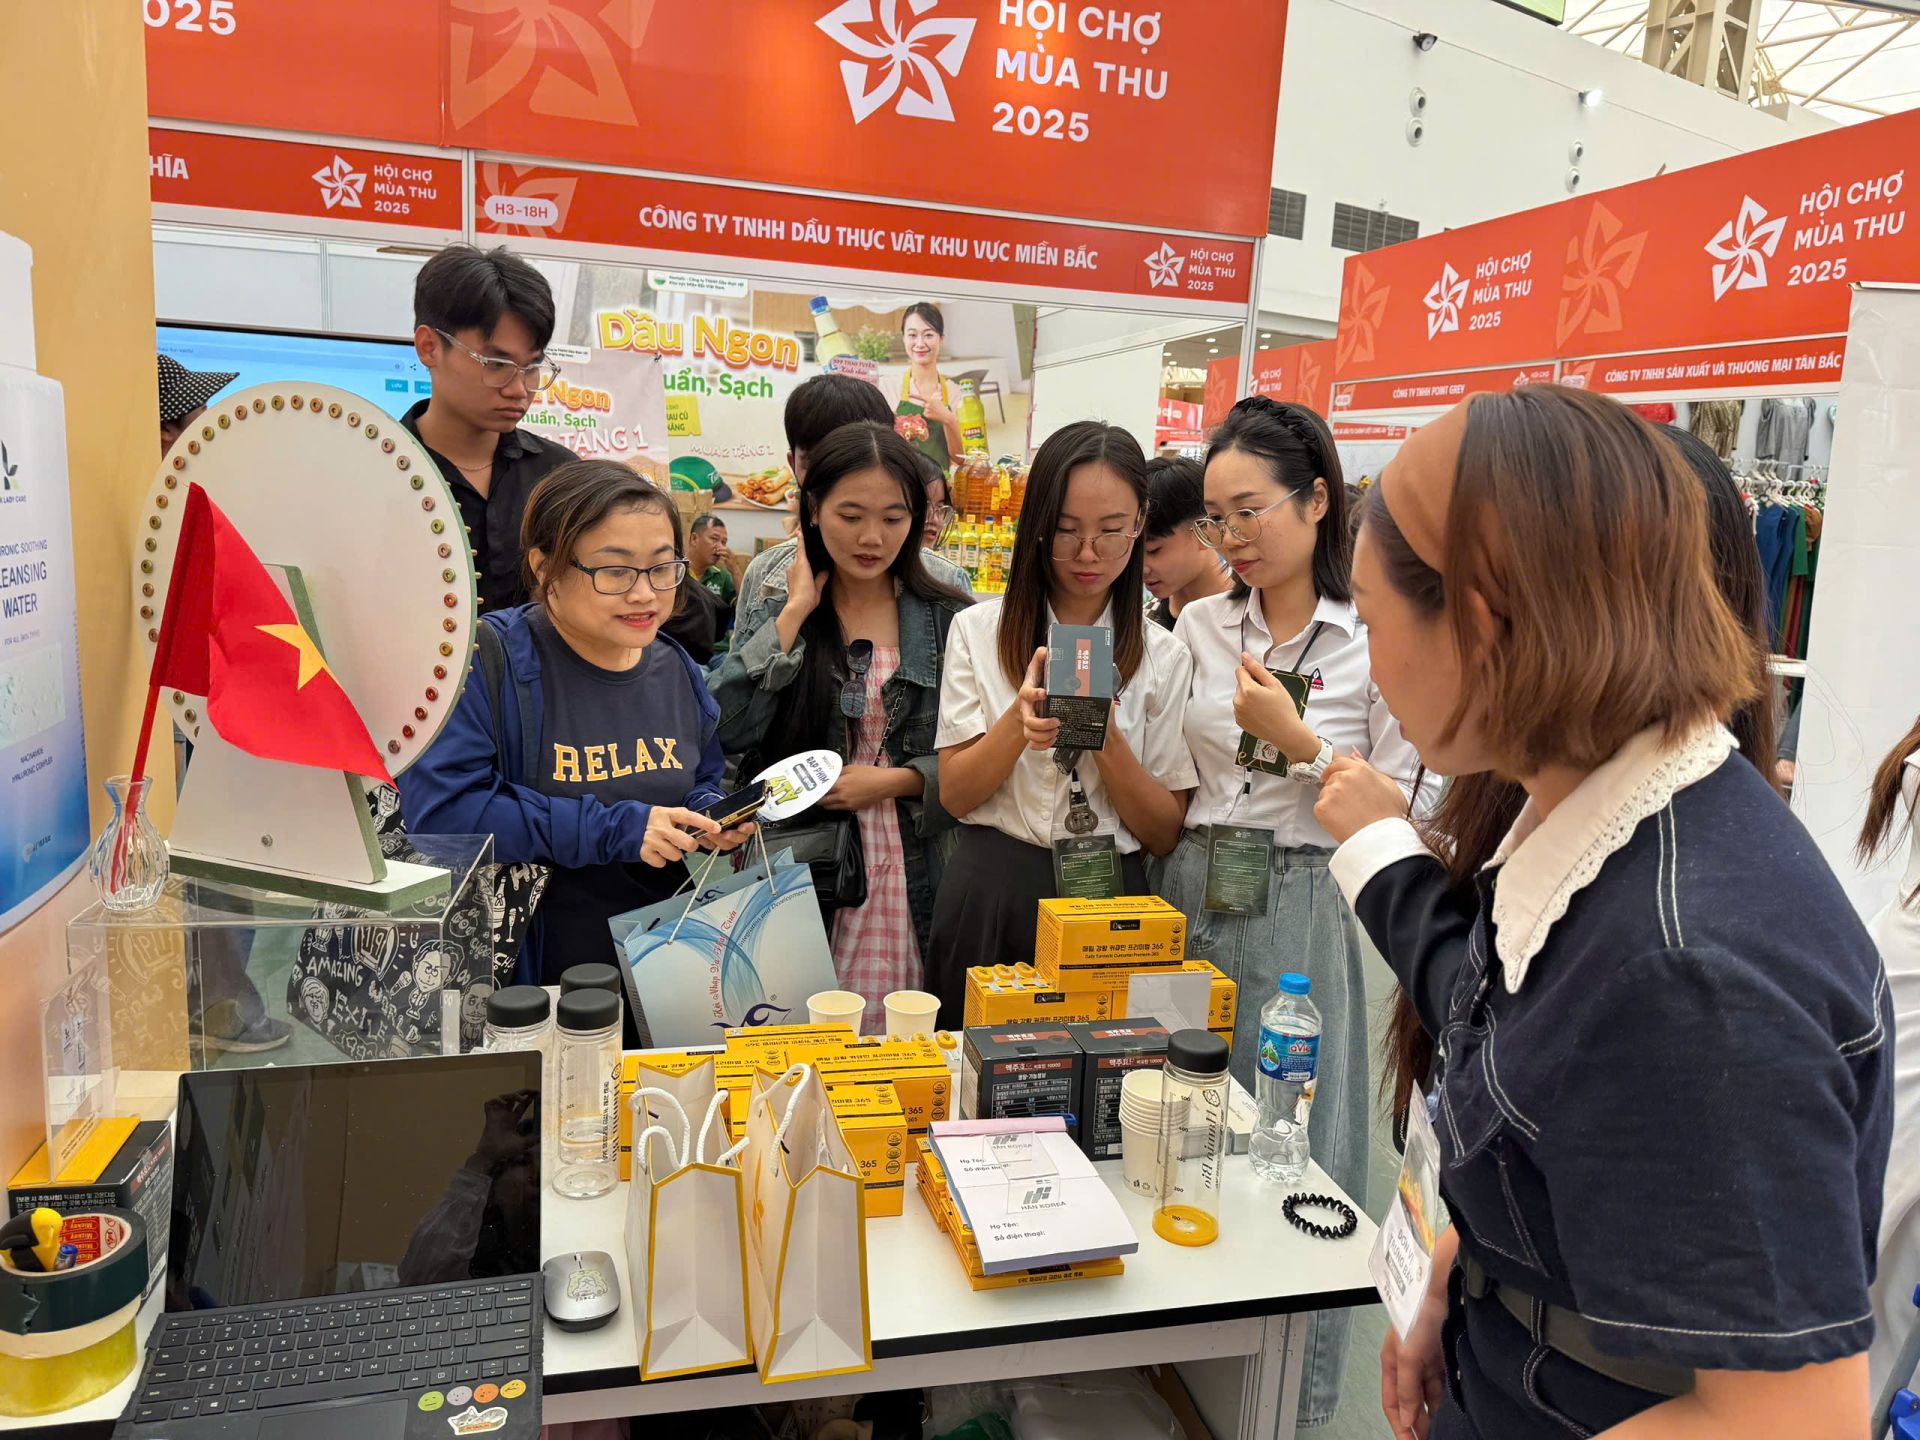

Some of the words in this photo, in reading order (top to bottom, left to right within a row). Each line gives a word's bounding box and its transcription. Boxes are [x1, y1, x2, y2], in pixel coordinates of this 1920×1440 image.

[1078, 6, 1161, 55] CHỢ
[996, 42, 1080, 89] MÙA
[1093, 62, 1168, 100] THU
[992, 102, 1089, 142] 2025
[373, 164, 399, 181] HỘI
[402, 167, 433, 184] CHỢ
[374, 180, 405, 198] MÙA
[409, 186, 437, 200] THU
[1800, 181, 1841, 217] HỘI
[1846, 170, 1904, 204] CHỢ
[374, 201, 410, 214] 2025
[495, 202, 548, 219] H3-18H
[639, 205, 697, 231] CÔNG
[703, 213, 728, 234] TY
[732, 215, 784, 240] TNHH
[791, 217, 831, 244] DẦU
[836, 224, 885, 253] THỰC
[891, 229, 925, 256] VẬT
[930, 236, 968, 258] KHU
[974, 237, 1010, 263] VỰC
[1015, 240, 1058, 266] MIỀN
[1064, 244, 1098, 270] BẮC
[1794, 218, 1845, 251] MÙA
[1852, 210, 1906, 241] THU
[1190, 248, 1208, 262] HỘI
[1211, 250, 1234, 265] CHỢ
[1476, 257, 1499, 281] HỘI
[1501, 250, 1532, 275] CHỢ
[1189, 262, 1213, 277] MÙA
[1215, 266, 1235, 278] THU
[1787, 257, 1847, 287] 2025
[1187, 279, 1214, 292] 2025
[1472, 280, 1500, 305] MÙA
[1504, 278, 1532, 301] THU
[1469, 311, 1501, 330] 2025
[598, 308, 683, 356] Dầu
[694, 315, 799, 372] Ngon
[1629, 370, 1640, 380] TY
[1641, 367, 1664, 379] TNHH
[548, 378, 610, 412] Ngon
[719, 372, 773, 401] Sạch
[564, 412, 596, 429] Sạch
[634, 424, 649, 450] 1
[21, 539, 47, 553] SOOTHING
[3, 593, 38, 619] WATER
[553, 738, 683, 782] RELAX
[739, 914, 763, 948] Integration
[1151, 942, 1164, 950] 365
[908, 1106, 923, 1115] 365
[860, 1160, 877, 1168] 365
[1039, 1200, 1066, 1209] KOREA
[1006, 1232, 1023, 1240] điện
